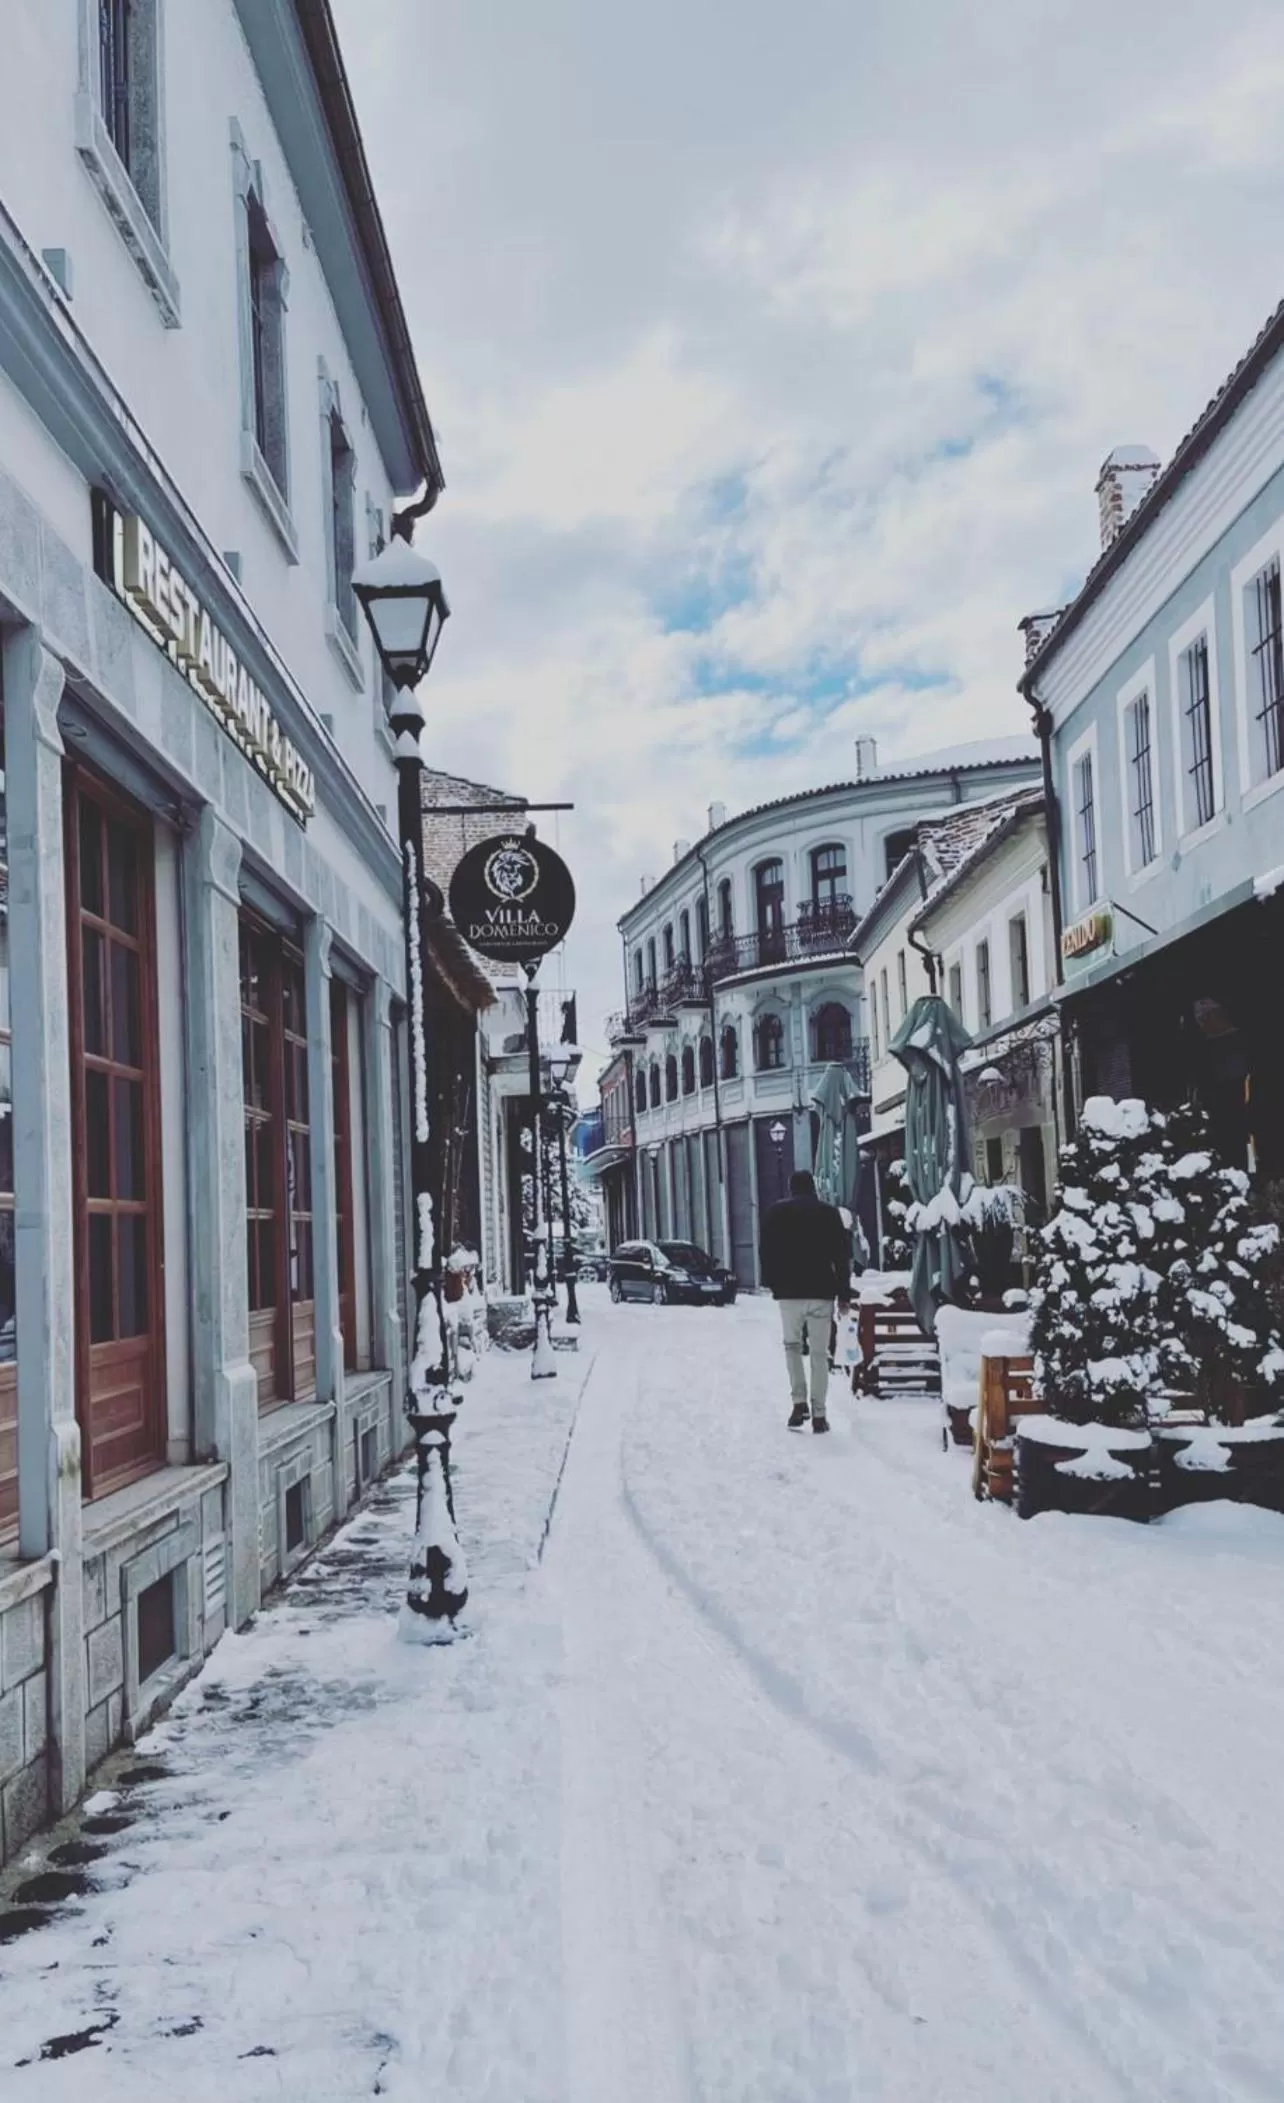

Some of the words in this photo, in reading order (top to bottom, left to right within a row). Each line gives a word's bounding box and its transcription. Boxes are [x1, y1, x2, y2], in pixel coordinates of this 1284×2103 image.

[133, 515, 271, 752] RESTAURANT
[284, 736, 315, 814] PIZZA
[485, 905, 541, 924] VILLA
[470, 922, 559, 940] DOMENICO
